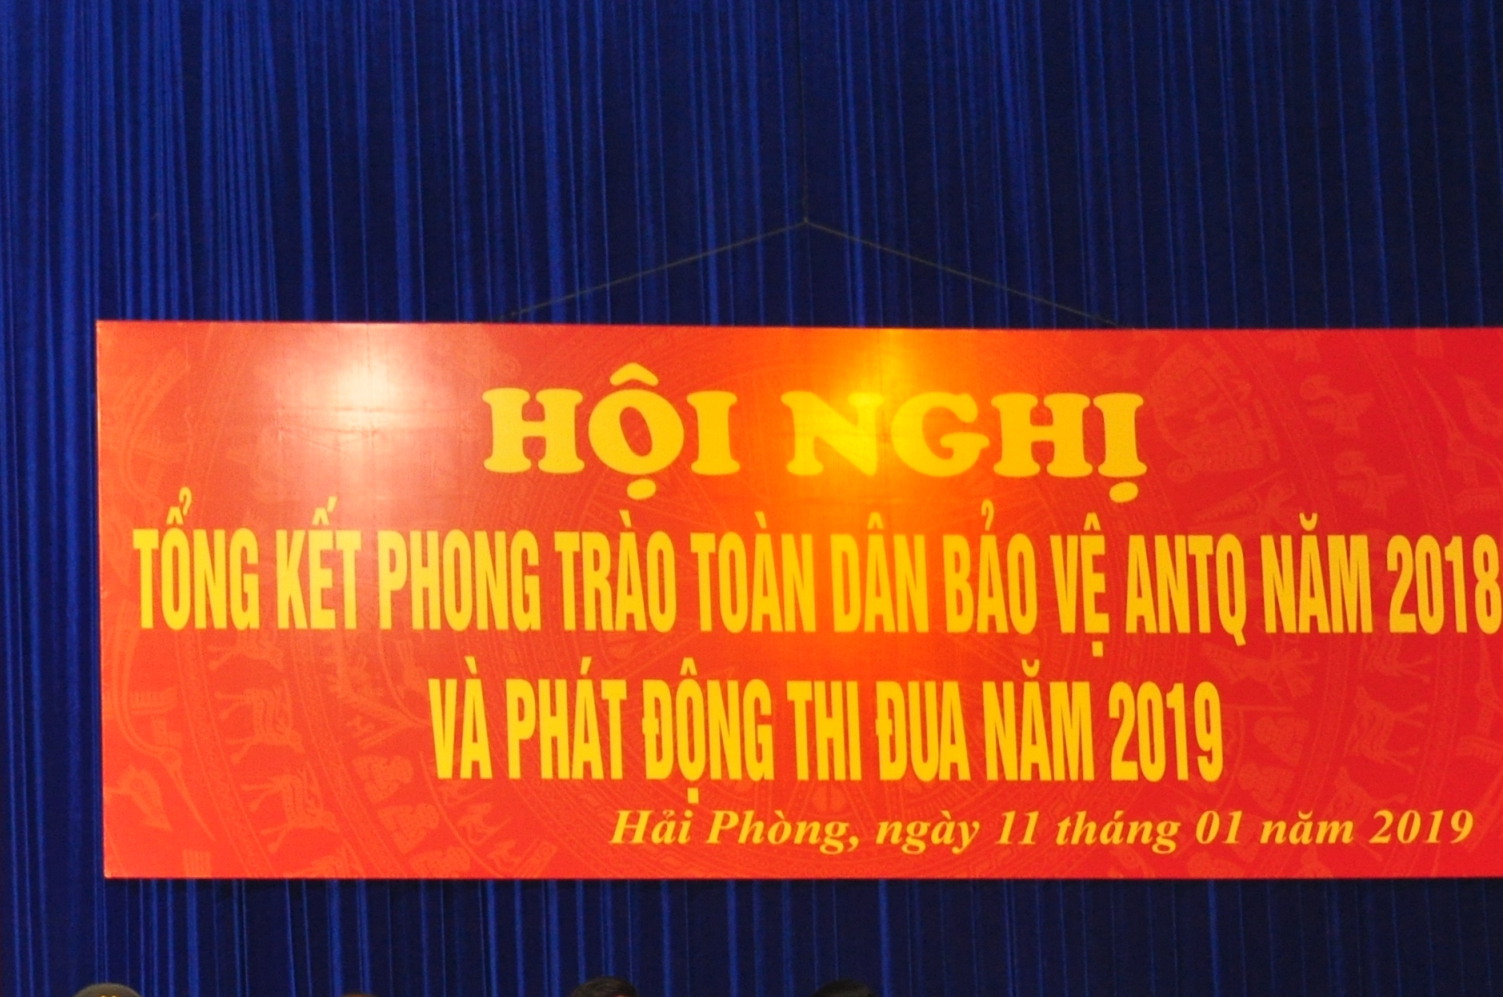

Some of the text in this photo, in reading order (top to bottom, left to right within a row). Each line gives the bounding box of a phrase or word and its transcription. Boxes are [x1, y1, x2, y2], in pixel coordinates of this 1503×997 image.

[481, 362, 1147, 503] HỘI NGHỊ
[133, 487, 1503, 657] TỔNG KẾT PHONG TRÀO TOÀN DÂN BẢO VỆ ANTQ NĂM 2018
[428, 656, 1224, 804] VÀ PHÁT ĐỘNG THI ĐUA NĂM 2019
[609, 809, 1474, 855] Hải Phòng, ngày 11 tháng 01 năm 2019
